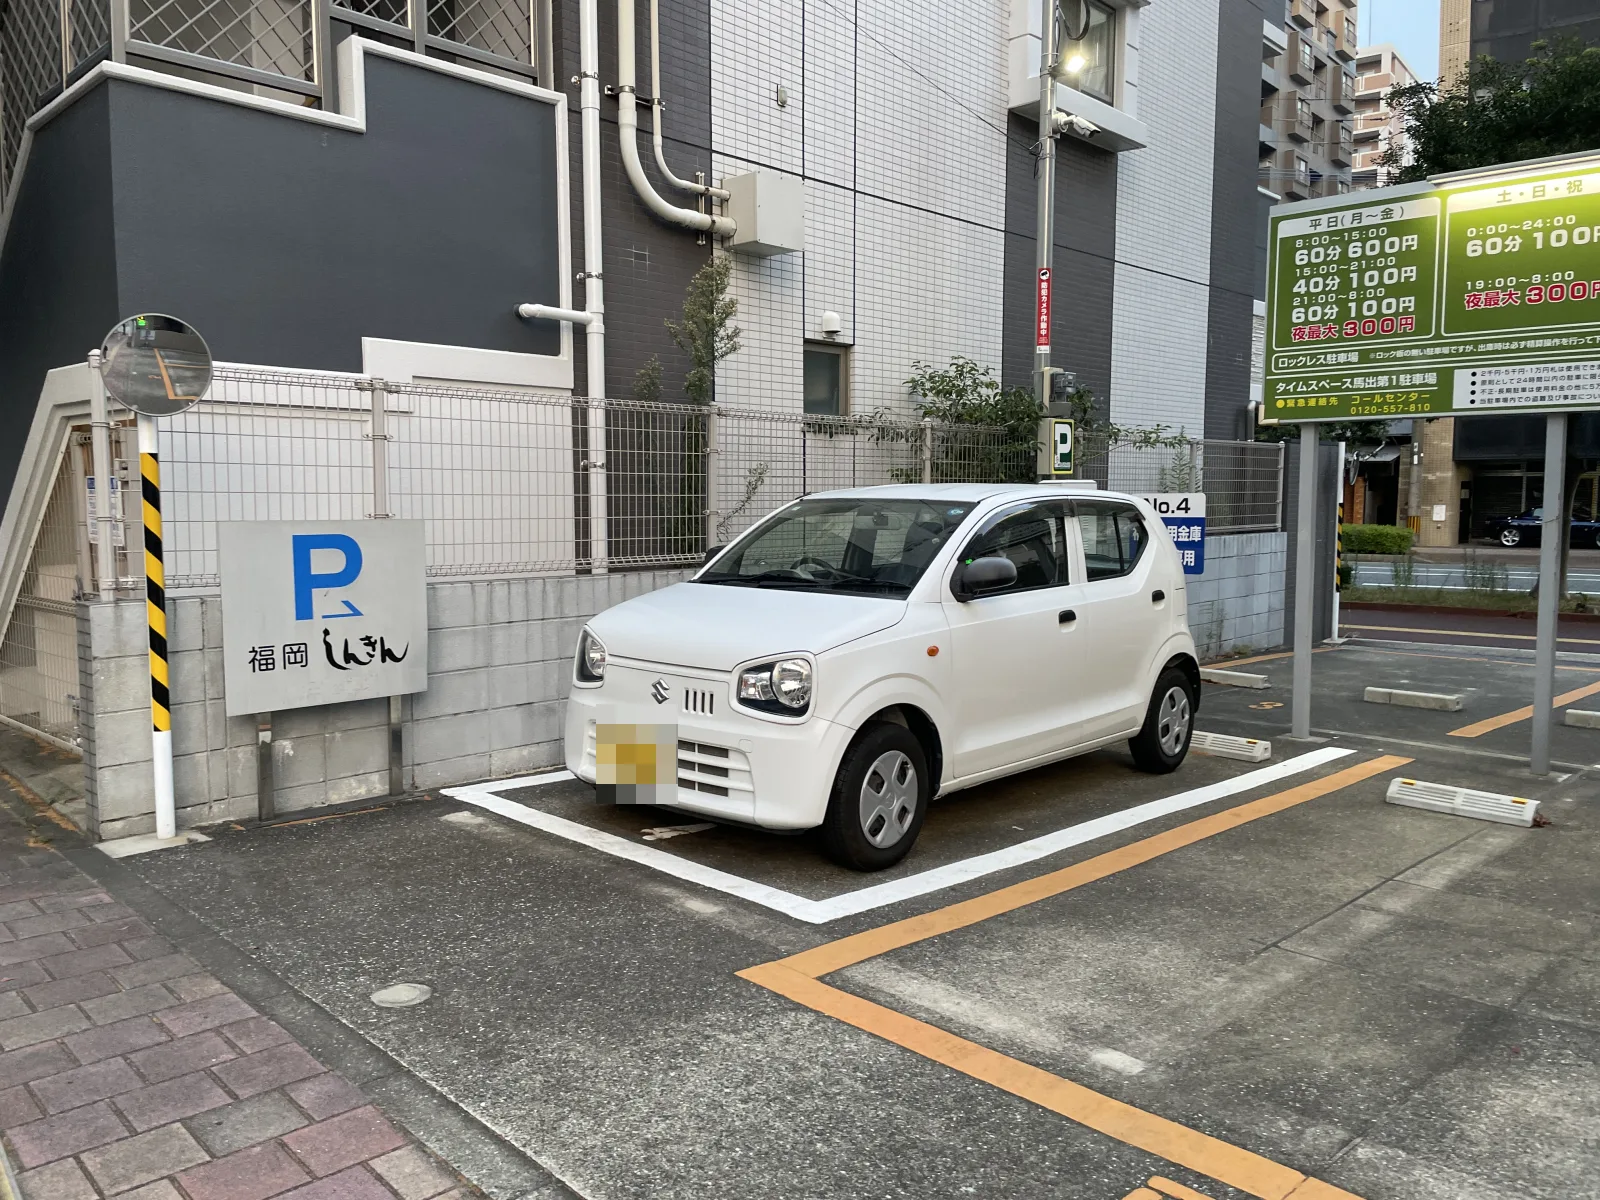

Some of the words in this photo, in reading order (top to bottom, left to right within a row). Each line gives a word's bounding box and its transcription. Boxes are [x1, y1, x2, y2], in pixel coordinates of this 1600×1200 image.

[1497, 180, 1583, 203] 土・日・祝
[1295, 245, 1342, 265] 60分
[1348, 235, 1418, 258] 600円
[1466, 235, 1523, 257] 60分
[1292, 276, 1341, 295] 40分
[1349, 266, 1417, 289] 100円
[1292, 304, 1339, 324] 60分
[1347, 296, 1415, 318] 100円
[1465, 292, 1521, 310] 夜最大
[1292, 323, 1338, 342] 夜最大
[1343, 315, 1416, 338] 300円
[1278, 352, 1359, 368] ロックレス駐車場
[1350, 403, 1431, 415] 0120-557-810
[1351, 393, 1431, 404] コールセンター
[1055, 423, 1072, 464] P
[292, 533, 364, 621] P
[248, 642, 309, 673] 福岡
[322, 627, 410, 671] しんきん
